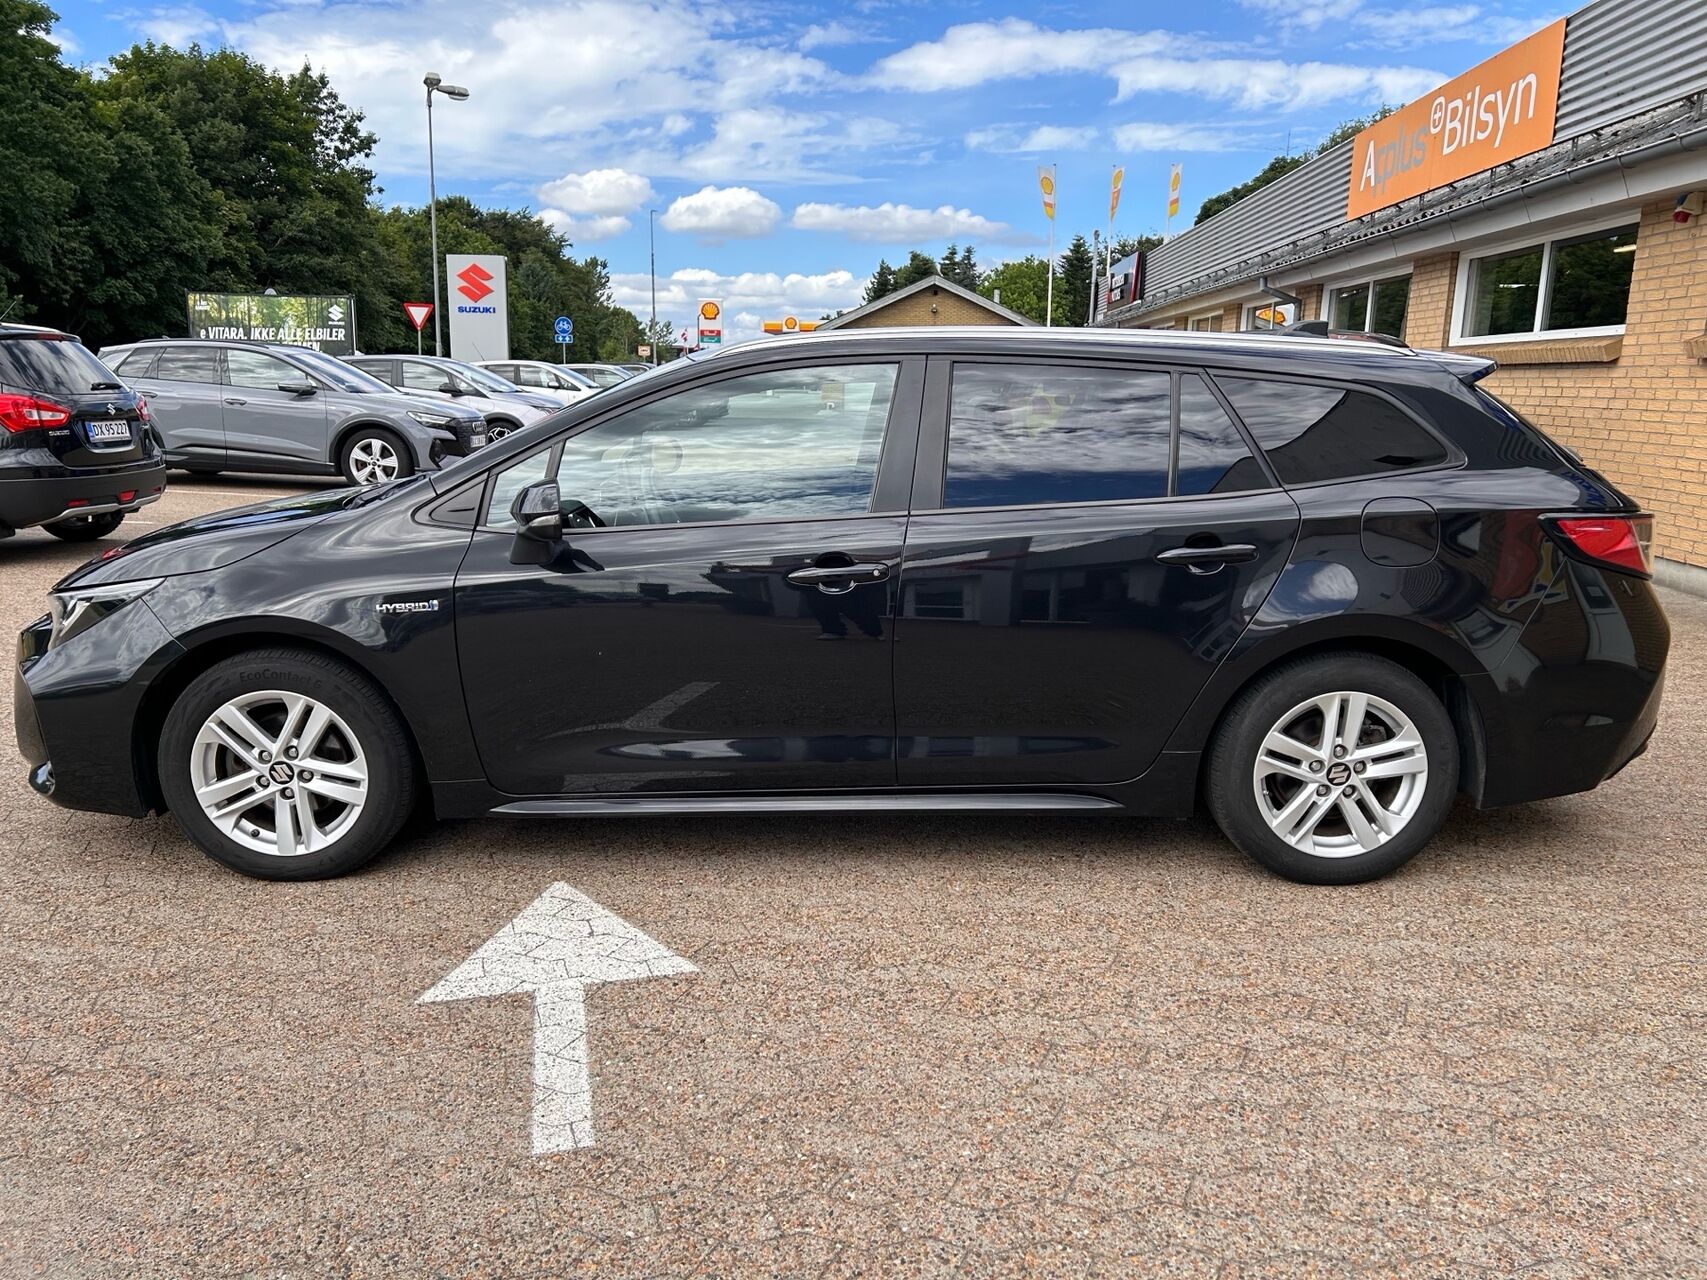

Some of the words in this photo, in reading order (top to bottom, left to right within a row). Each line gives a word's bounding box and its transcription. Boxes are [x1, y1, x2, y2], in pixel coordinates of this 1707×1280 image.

[1442, 73, 1537, 156] Bilsyn
[457, 306, 496, 314] SUZUKI
[208, 326, 247, 340] VITARA.
[250, 327, 275, 341] IKKE
[277, 327, 304, 341] ALLE
[305, 327, 345, 341] ELBILER
[93, 424, 105, 436] DX
[376, 602, 430, 613] HYBRID
[239, 668, 312, 682] EcoContact
